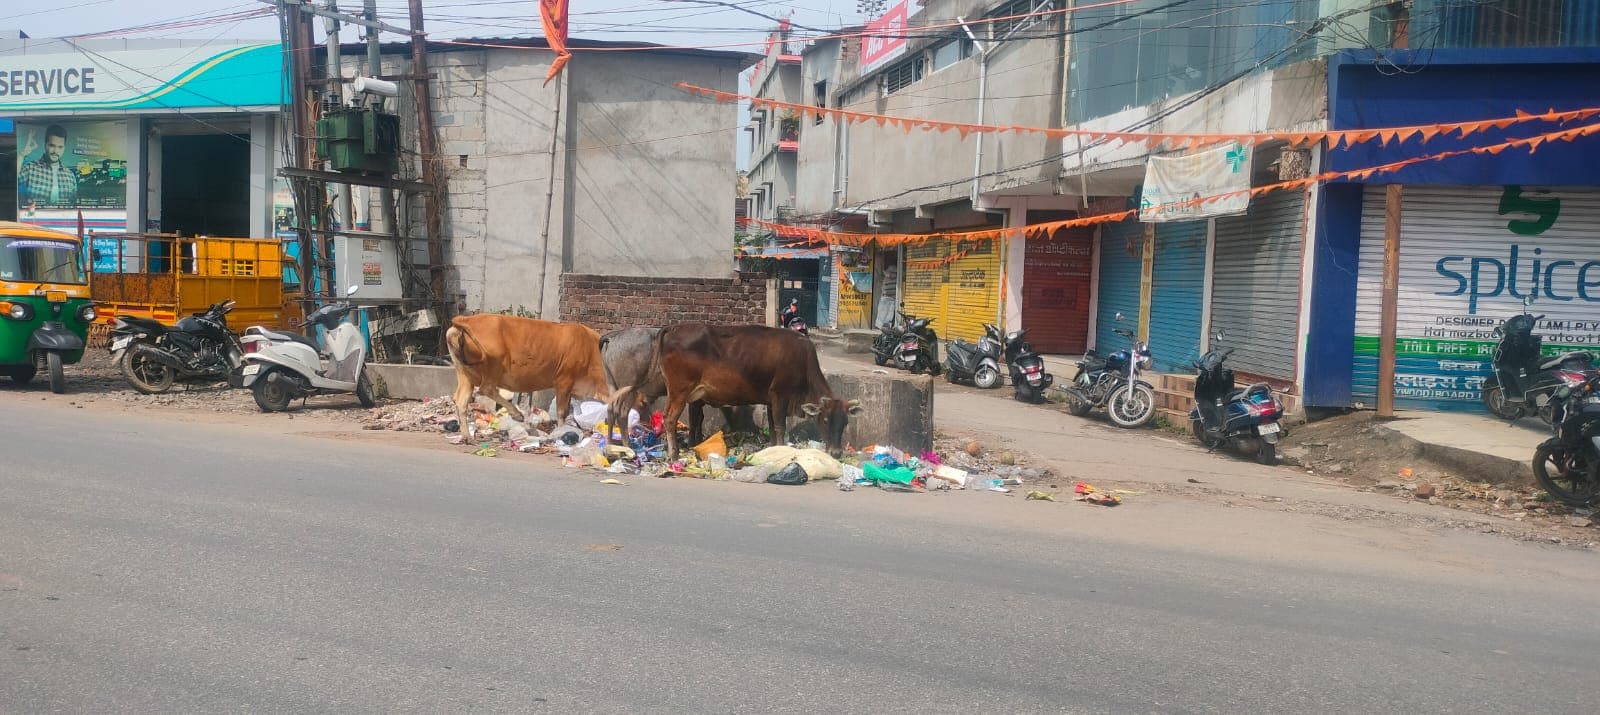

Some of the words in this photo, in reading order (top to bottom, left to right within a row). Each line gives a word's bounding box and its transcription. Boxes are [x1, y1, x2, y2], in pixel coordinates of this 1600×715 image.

[0, 67, 95, 96] SERVICE
[1435, 244, 1600, 314] splice
[1436, 316, 1494, 328] DESIGNER
[1402, 341, 1432, 353] TOLL
